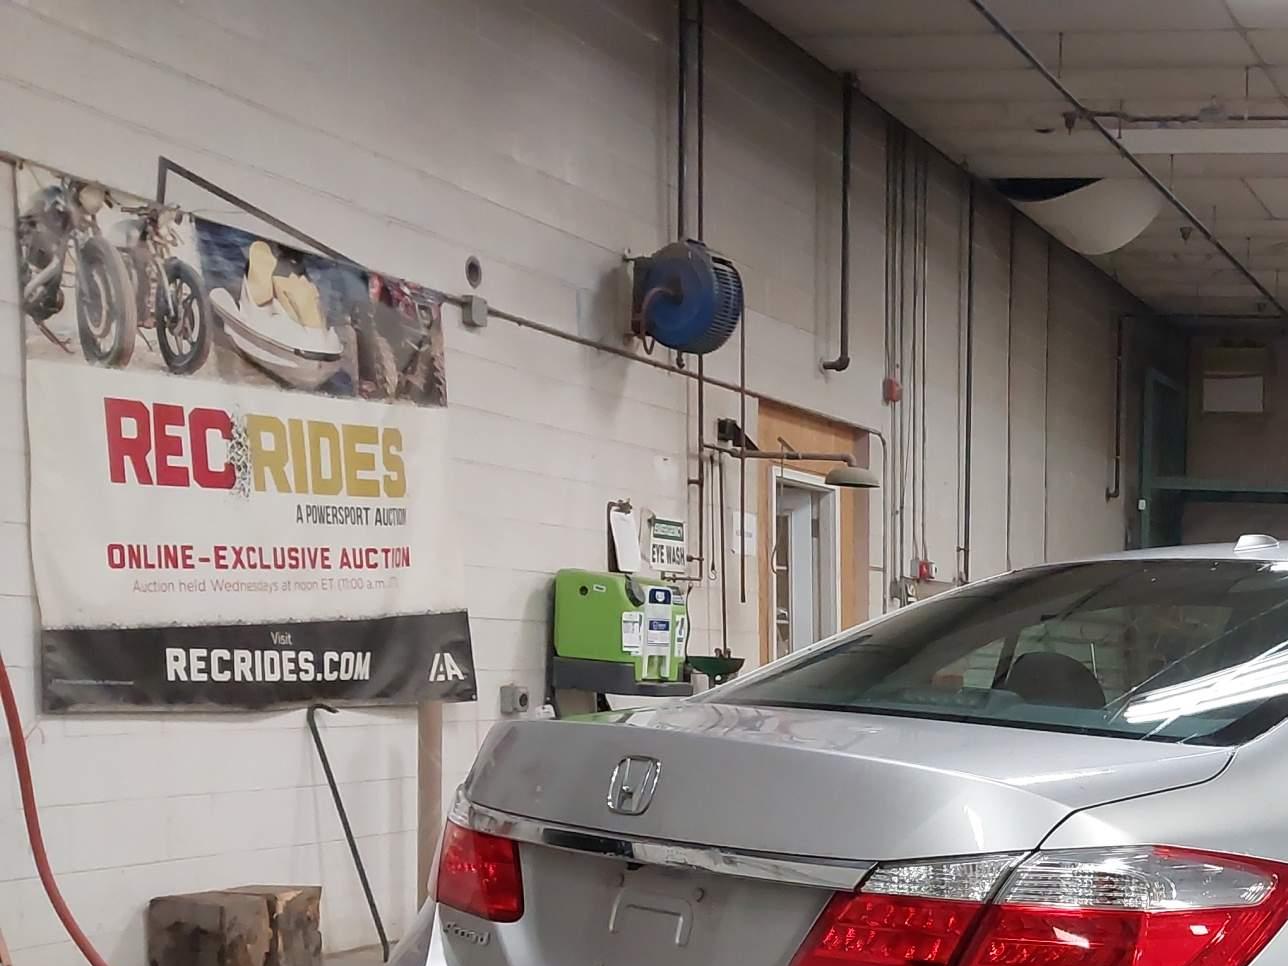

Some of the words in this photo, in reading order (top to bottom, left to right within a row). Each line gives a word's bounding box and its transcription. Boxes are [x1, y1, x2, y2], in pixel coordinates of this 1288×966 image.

[296, 504, 304, 524] A
[306, 504, 370, 526] POWERSPORT
[374, 508, 407, 526] AUCTION
[107, 543, 332, 570] ONLINE-EXCLUSIVE
[339, 546, 411, 569] AUCTION
[652, 543, 664, 563] EYE
[666, 545, 685, 566] WASH
[132, 580, 174, 592] Auction
[179, 579, 206, 592] held
[211, 579, 279, 594] Wednesdays
[282, 580, 292, 592] at
[294, 580, 319, 592] noon
[321, 578, 334, 590] ET
[271, 632, 293, 646] Visit
[165, 647, 372, 682] RECRIDES.COM
